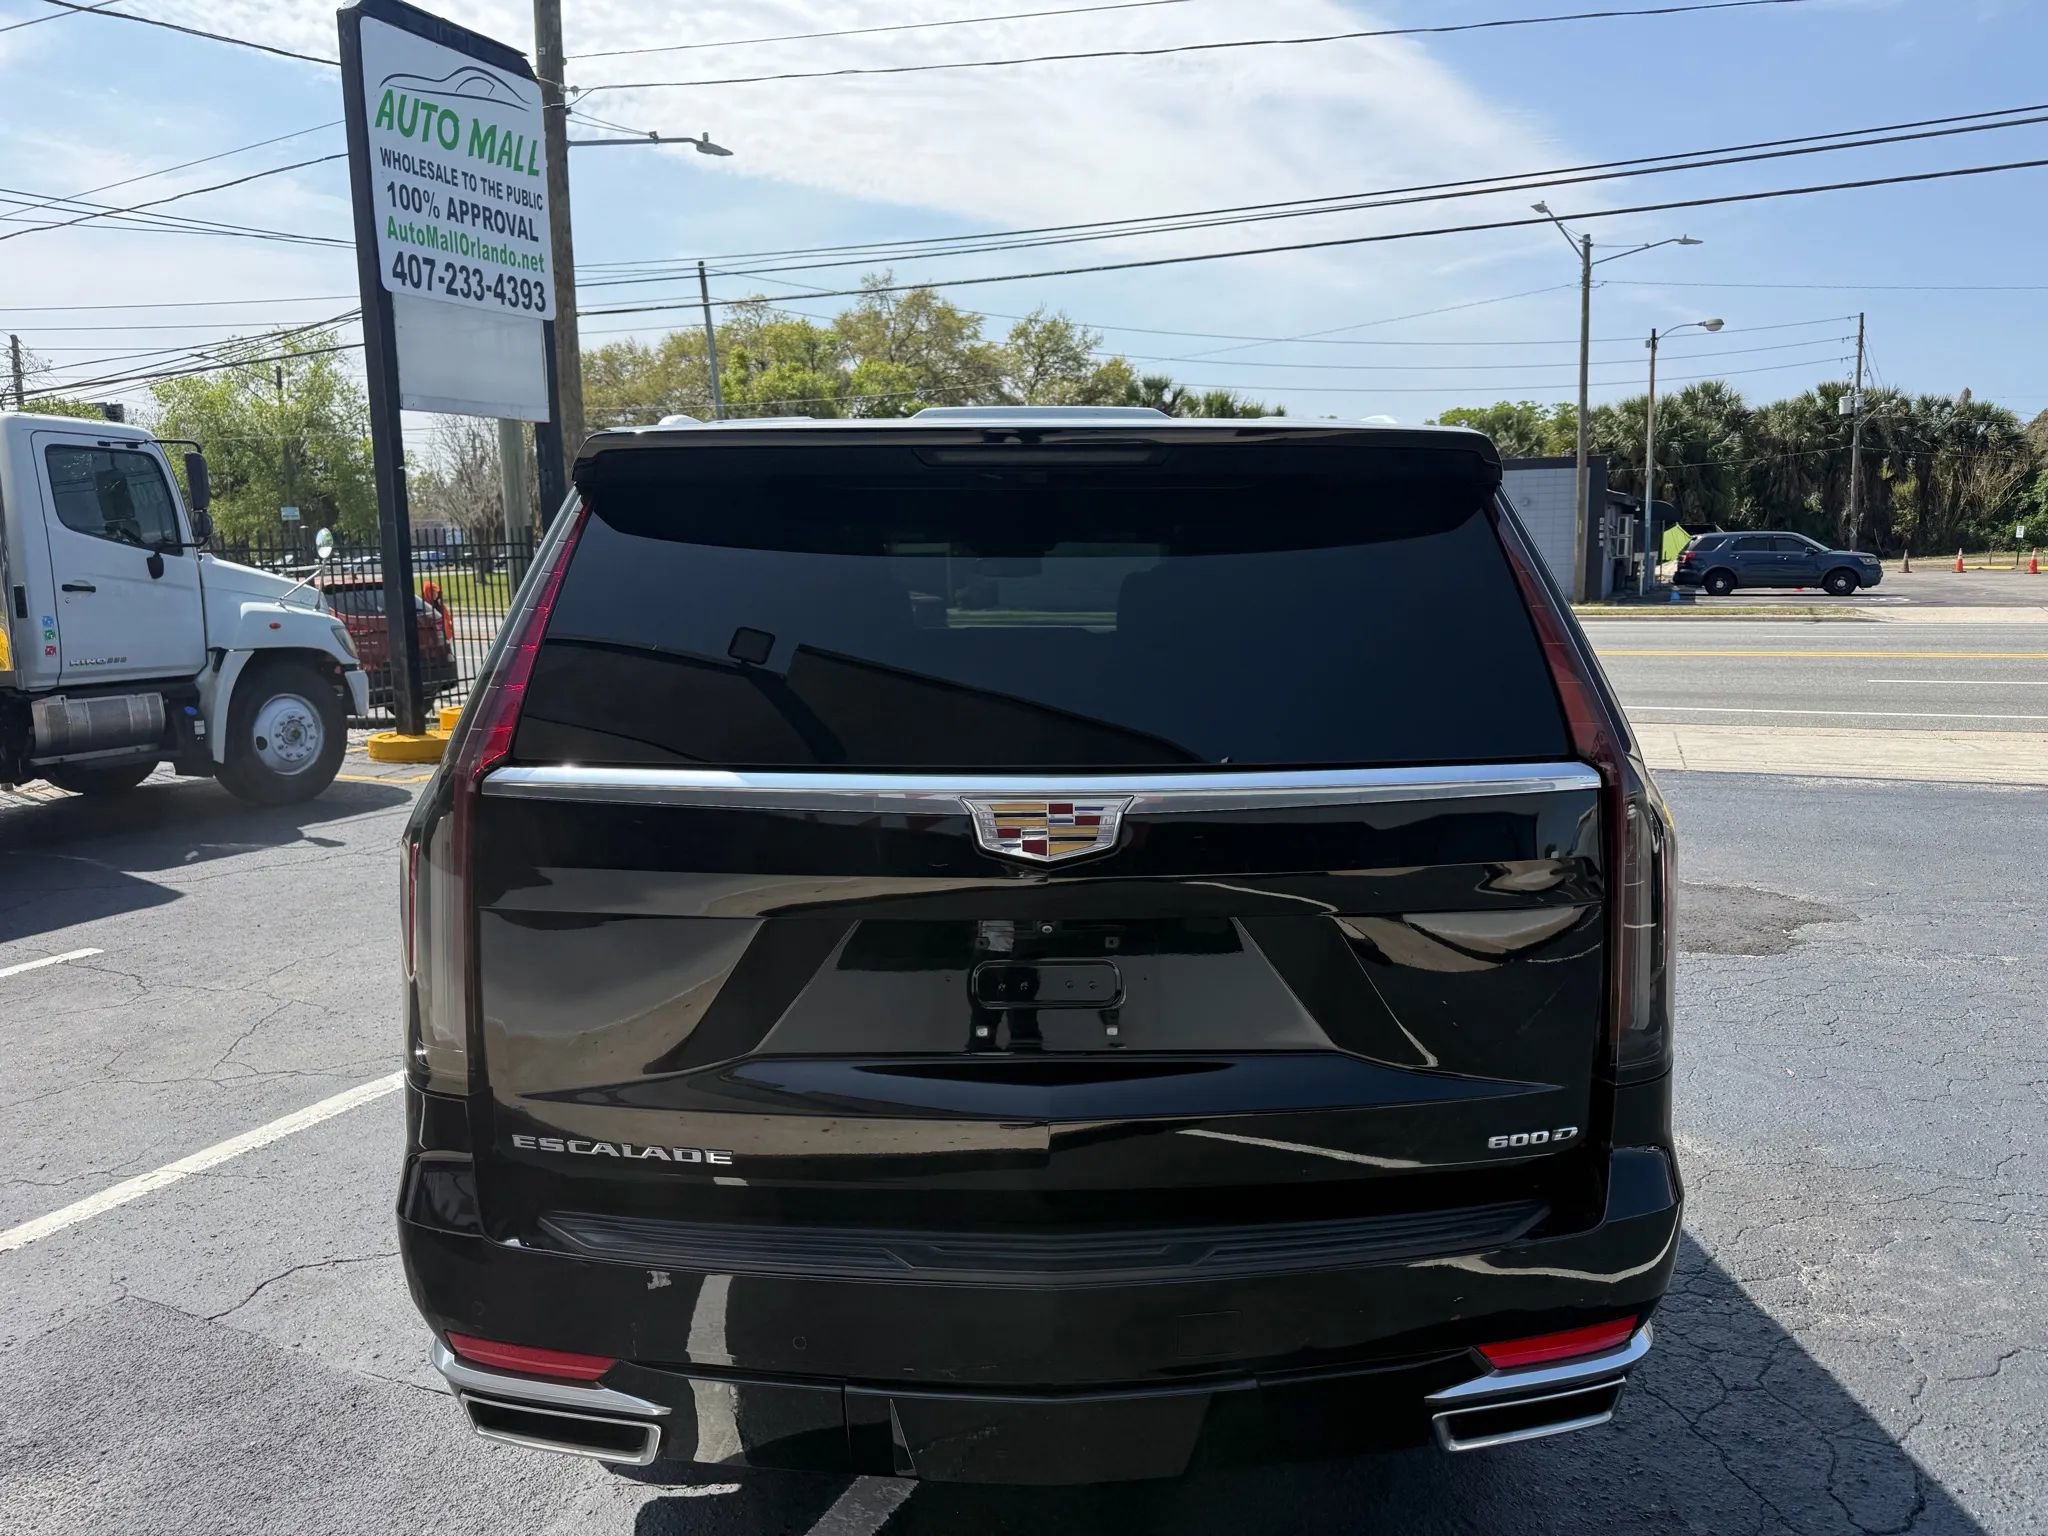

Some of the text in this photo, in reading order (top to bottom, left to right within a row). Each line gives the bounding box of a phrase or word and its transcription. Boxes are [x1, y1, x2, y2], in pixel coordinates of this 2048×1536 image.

[375, 88, 540, 177] AUTO MALL
[380, 146, 543, 211] WHOLESALE TO THE PUBLIC
[387, 181, 539, 242] 100% APPROVAL
[387, 215, 545, 273] AutoMallOrlando.net
[392, 251, 547, 313] 407-233-4393
[511, 1134, 734, 1165] ESCALADE
